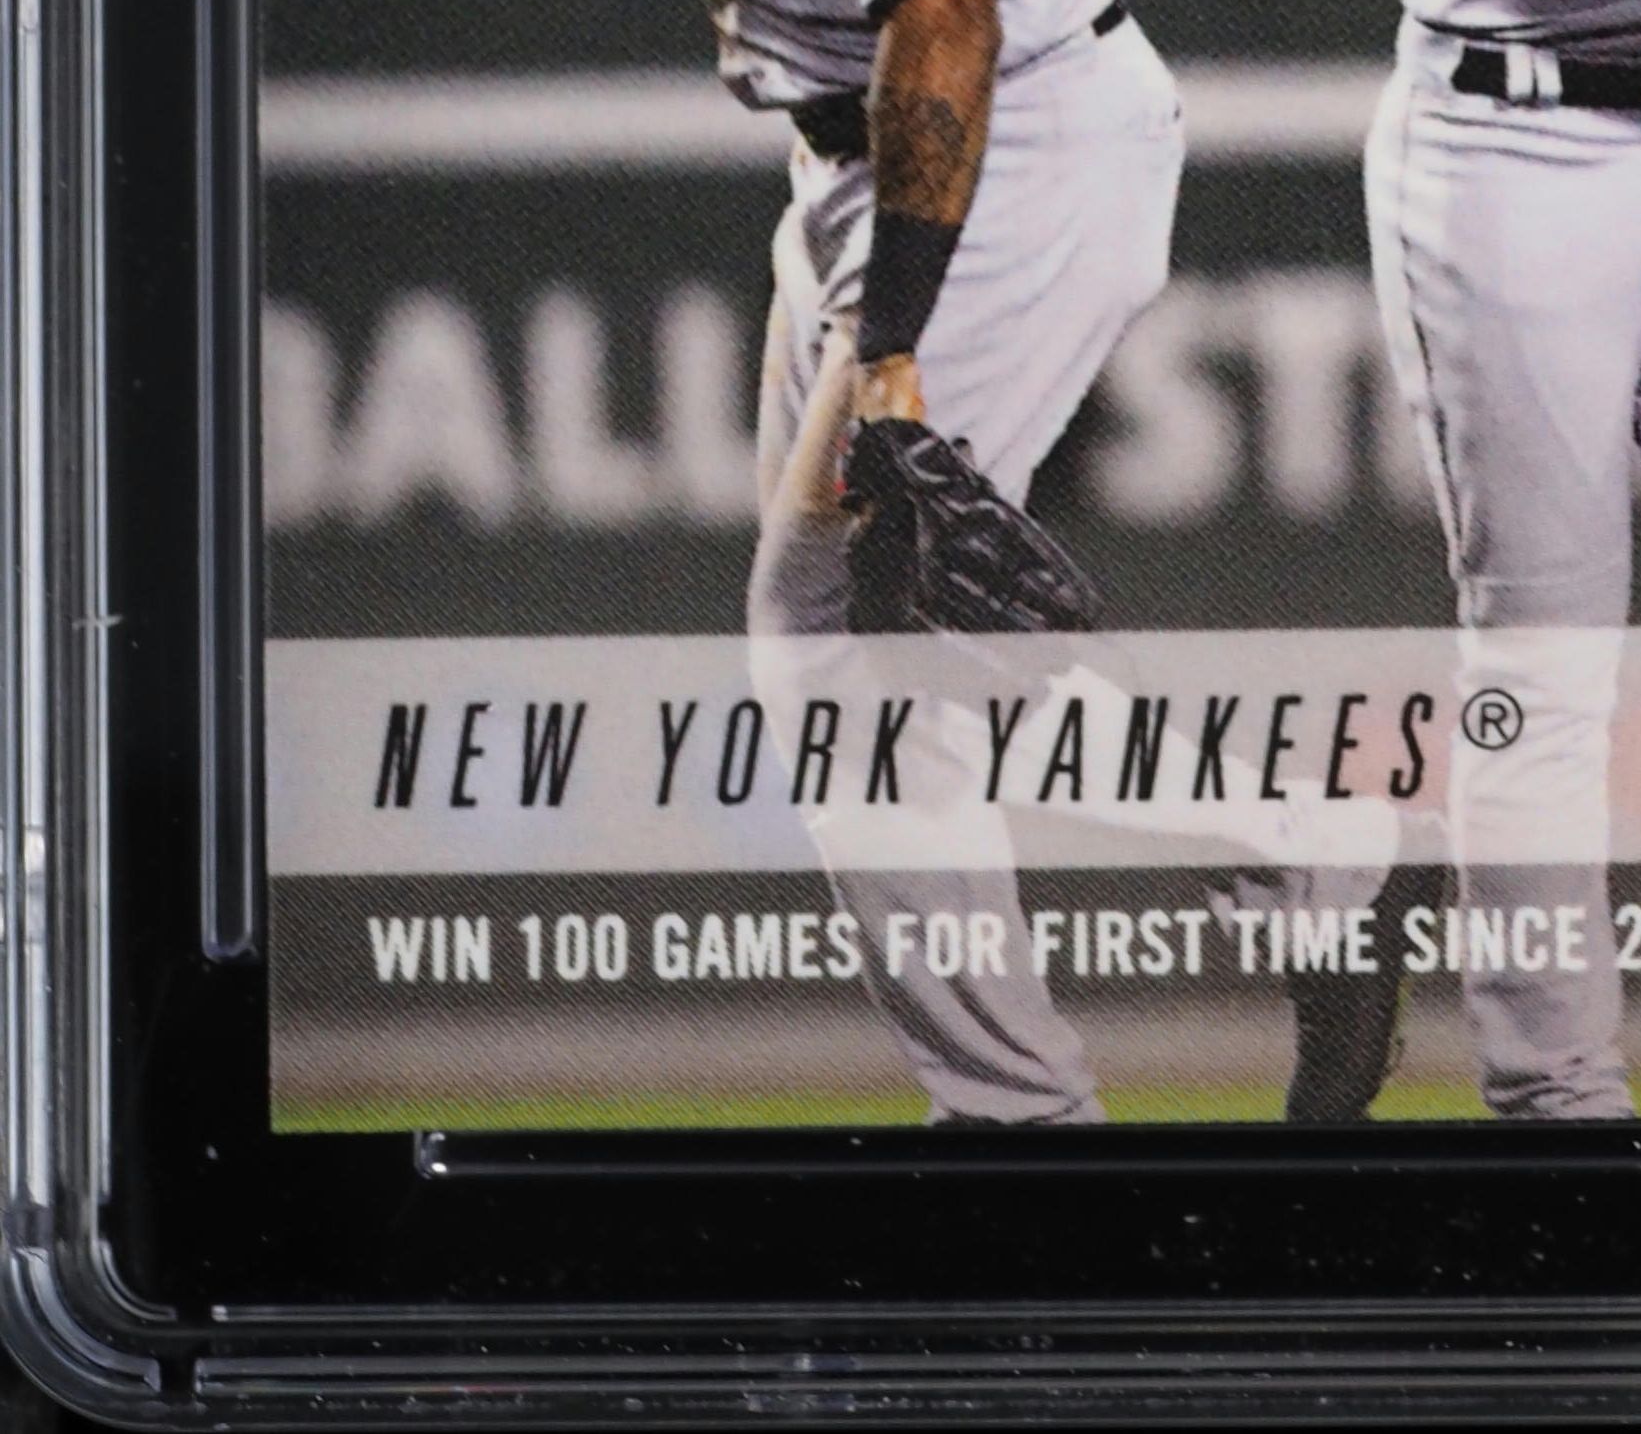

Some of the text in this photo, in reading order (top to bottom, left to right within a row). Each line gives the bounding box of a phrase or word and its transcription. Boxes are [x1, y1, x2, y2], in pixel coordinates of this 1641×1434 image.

[373, 699, 589, 809] NEW
[654, 698, 915, 806] YORK
[367, 915, 493, 983] WIN
[517, 913, 630, 982] 100
[652, 912, 864, 979] GAMES
[886, 910, 1007, 979] FOR
[1031, 908, 1207, 977] FIRST
[1231, 907, 1379, 975] TIME
[1402, 904, 1588, 972] SINCE
